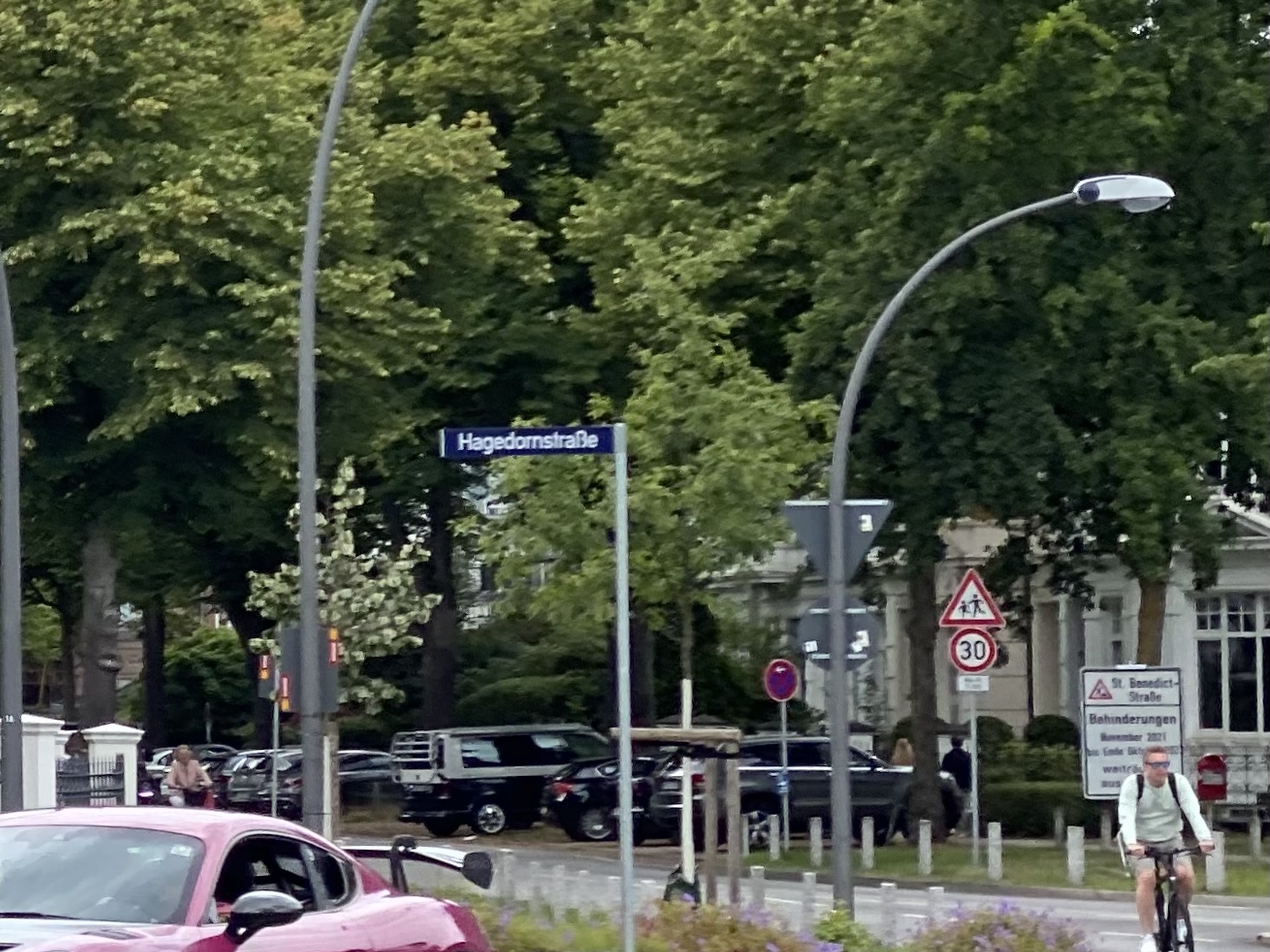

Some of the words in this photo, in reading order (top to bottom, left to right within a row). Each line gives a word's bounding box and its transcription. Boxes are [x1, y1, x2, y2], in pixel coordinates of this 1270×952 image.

[457, 430, 599, 455] Hagedornstraße
[960, 640, 986, 660] 30
[1129, 691, 1162, 702] Straße
[1089, 713, 1177, 727] Behinderungen
